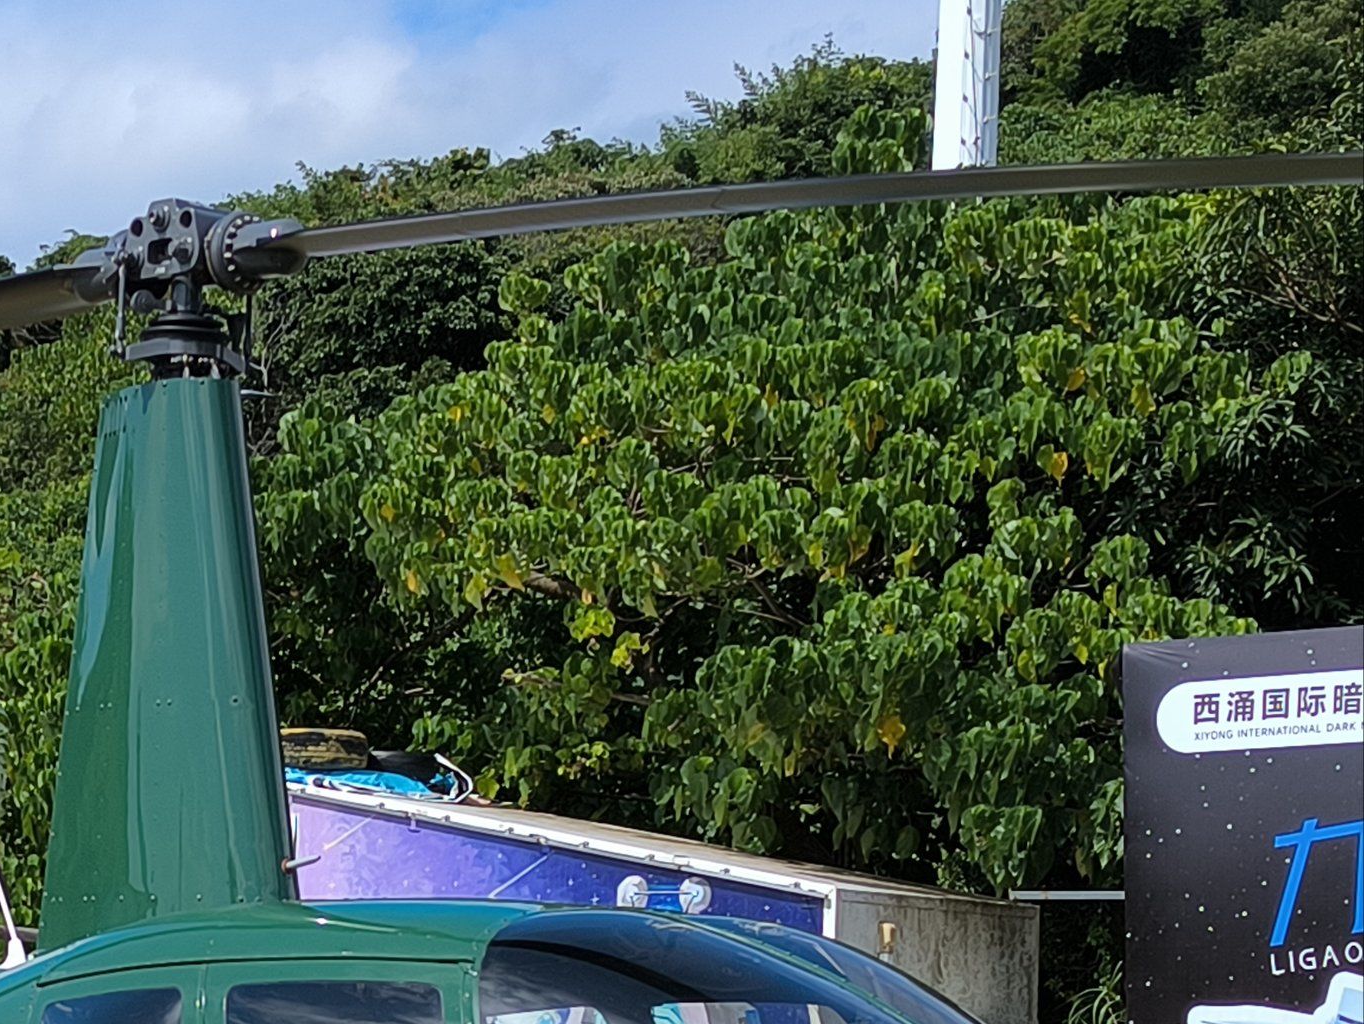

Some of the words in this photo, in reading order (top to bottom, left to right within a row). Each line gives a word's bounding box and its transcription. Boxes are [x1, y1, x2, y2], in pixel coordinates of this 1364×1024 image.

[1193, 682, 1363, 725] 西涌国际暗
[1194, 729, 1233, 741] XIYONG
[1237, 724, 1321, 738] INTERNATIONAL
[1326, 721, 1356, 733] DARK
[1270, 941, 1364, 976] LIGAO
